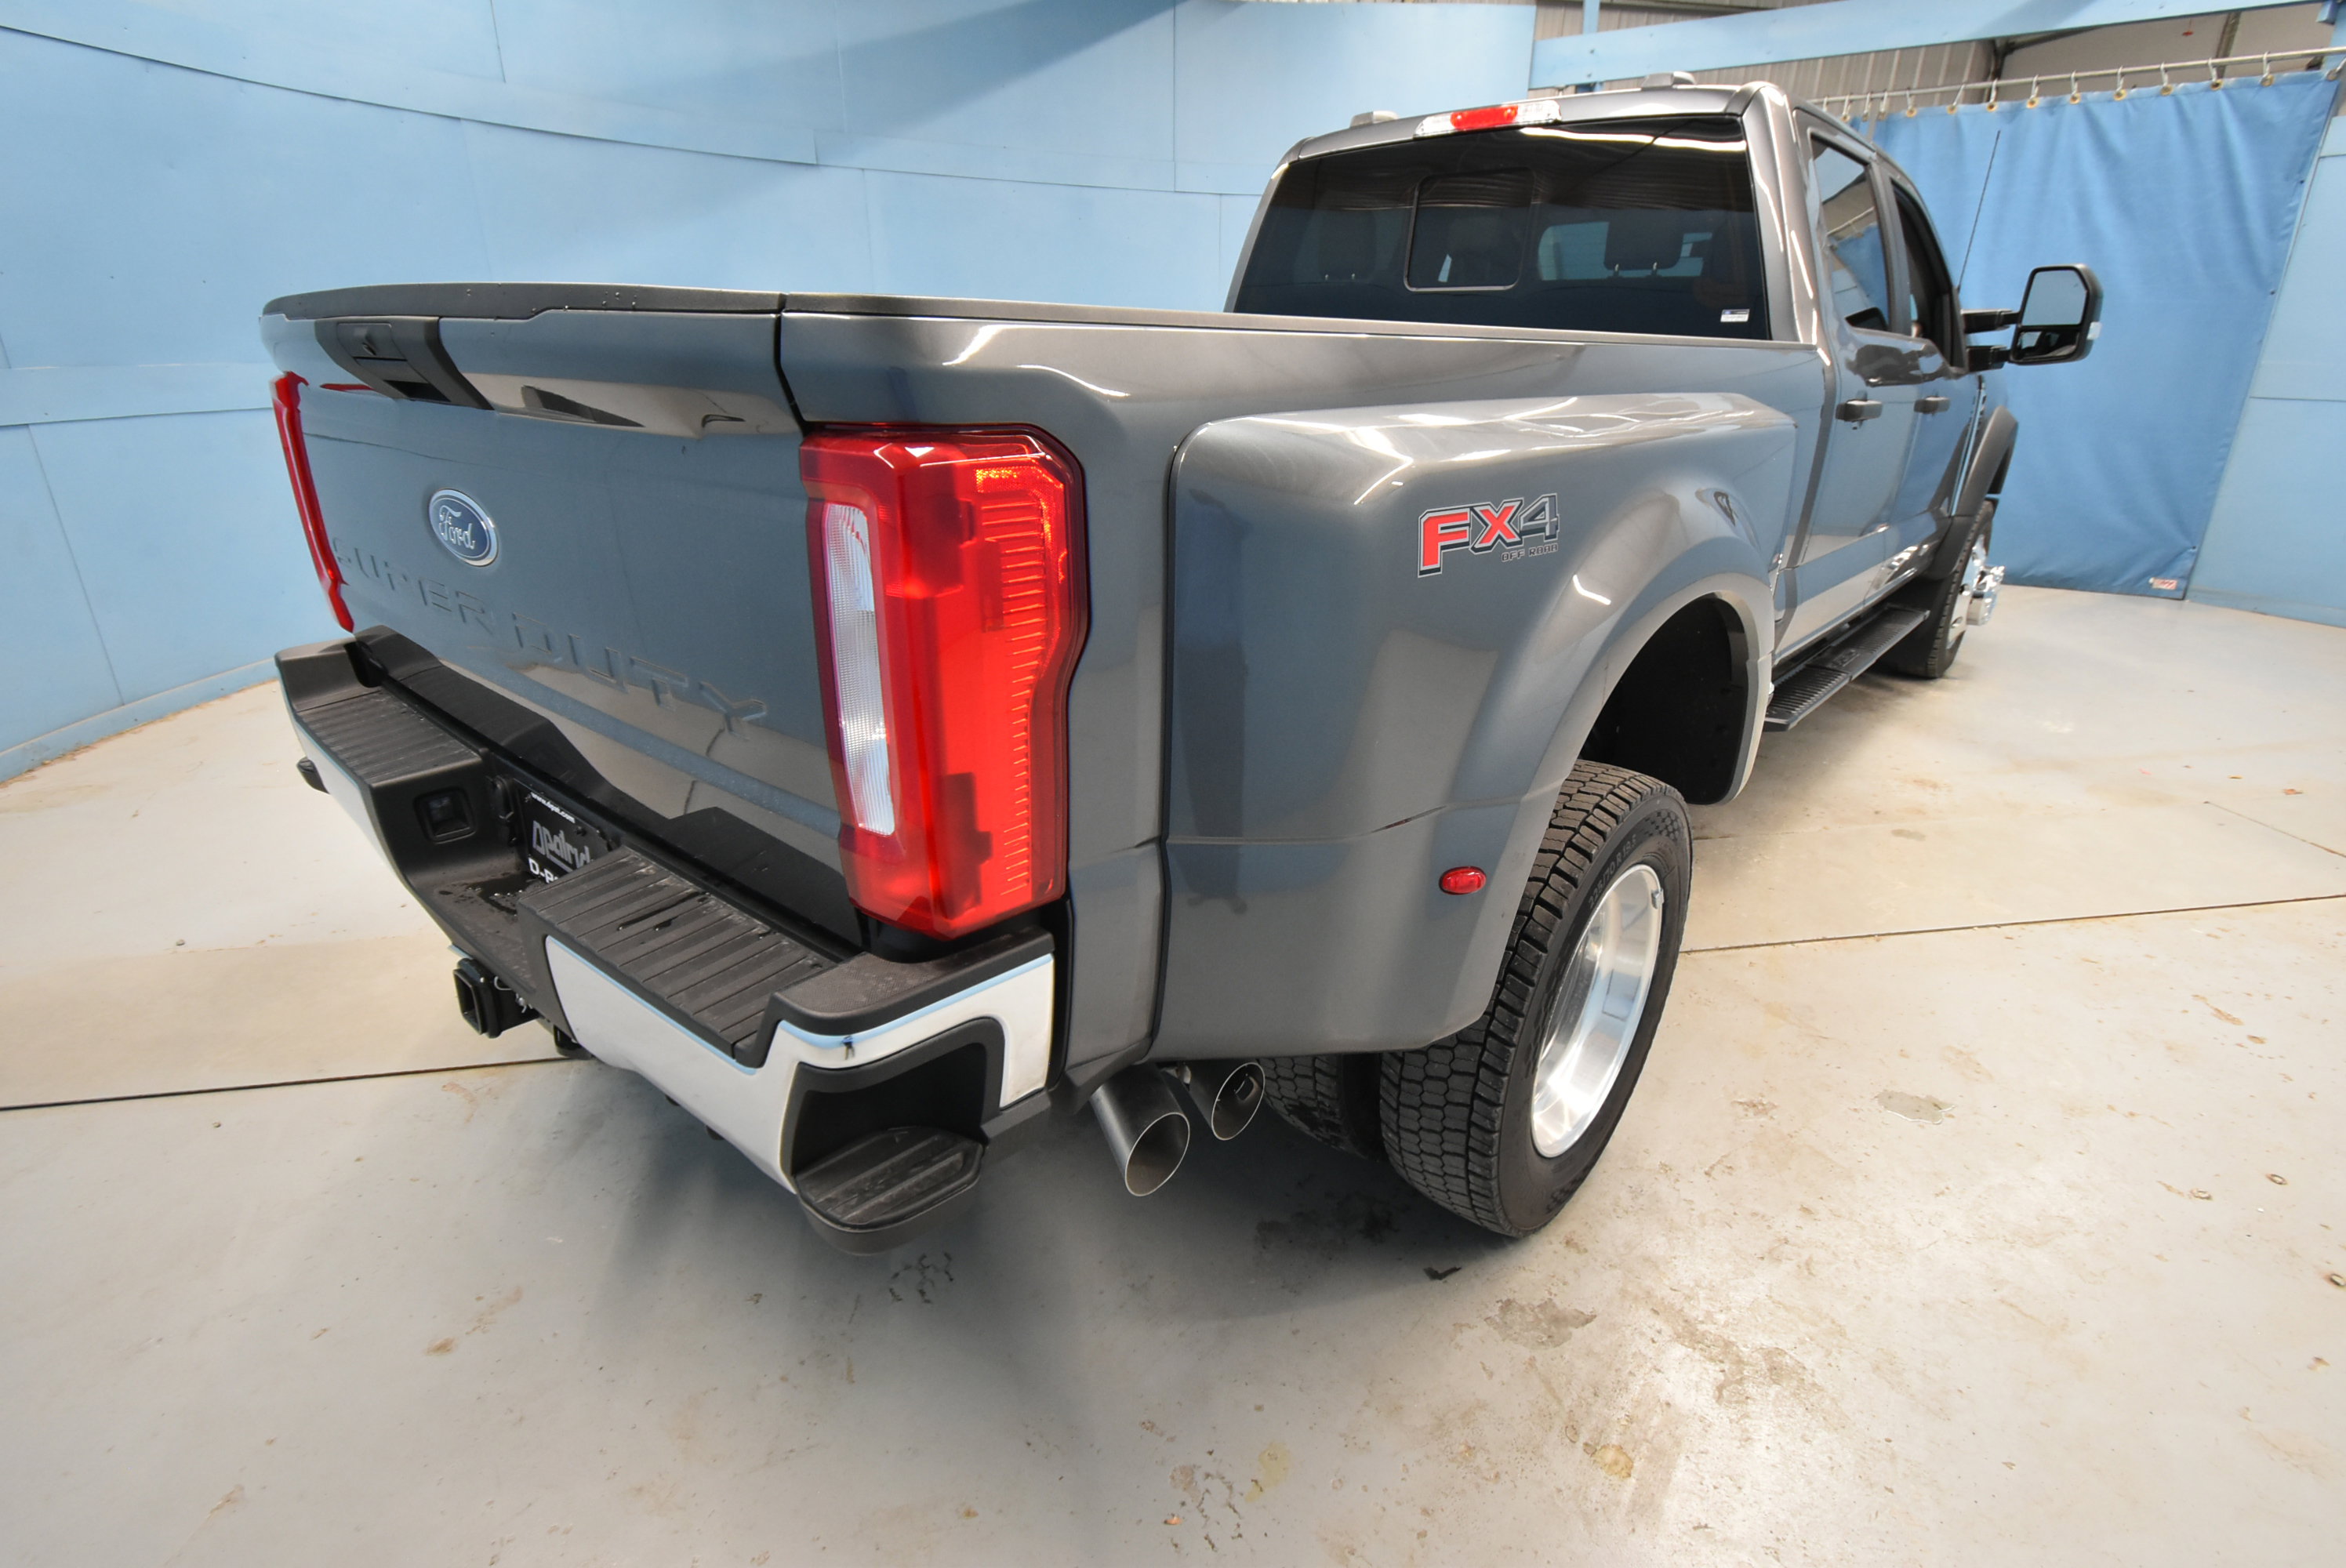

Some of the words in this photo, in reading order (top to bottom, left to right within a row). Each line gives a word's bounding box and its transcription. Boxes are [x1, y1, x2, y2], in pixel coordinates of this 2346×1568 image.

[438, 505, 476, 550] Ford
[1418, 493, 1560, 578] FX4
[1501, 549, 1525, 562] OFF
[1529, 543, 1559, 557] ROAD
[331, 537, 493, 635] SUPER
[511, 610, 768, 742] DUTY
[528, 857, 558, 884] D-P
